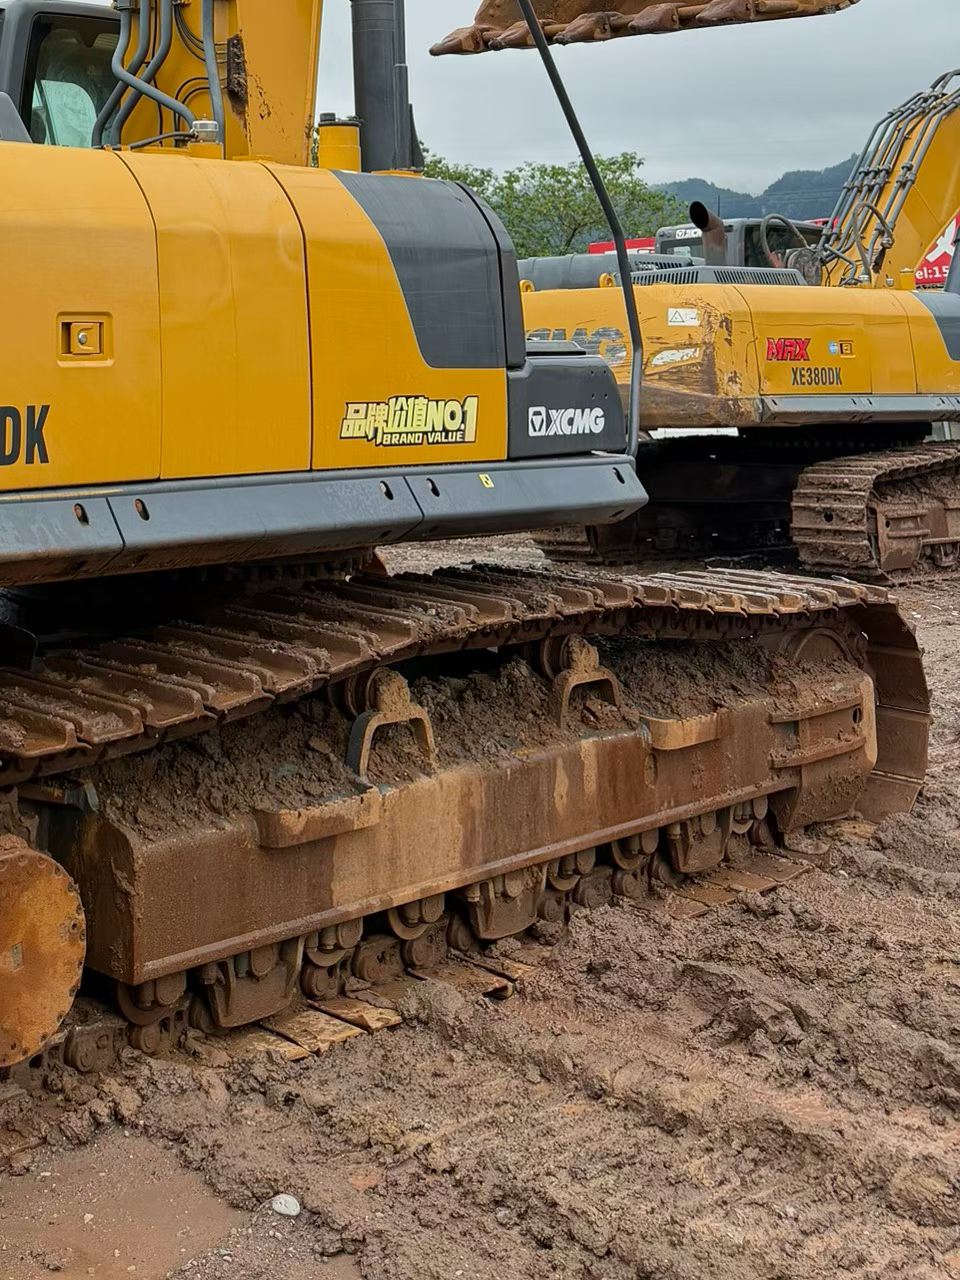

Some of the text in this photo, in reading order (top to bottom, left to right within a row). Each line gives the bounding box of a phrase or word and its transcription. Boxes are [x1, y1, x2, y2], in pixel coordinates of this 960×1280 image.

[766, 337, 811, 361] MAX
[791, 367, 843, 386] XE380DK
[545, 407, 605, 436] XCMG
[383, 431, 464, 445] BRAND VALUE
